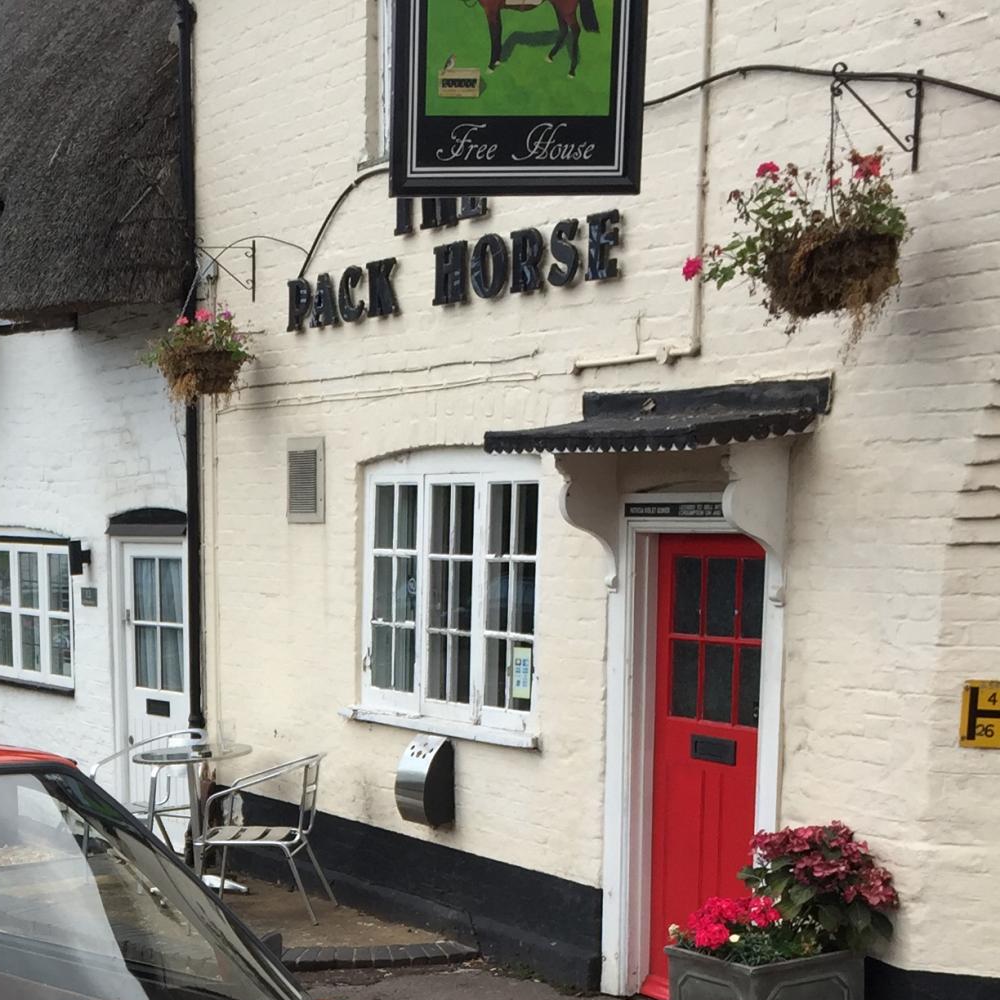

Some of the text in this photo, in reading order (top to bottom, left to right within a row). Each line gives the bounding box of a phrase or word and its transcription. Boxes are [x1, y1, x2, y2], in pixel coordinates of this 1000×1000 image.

[436, 122, 596, 162] Free House
[286, 209, 620, 333] PACK HORSE
[976, 723, 995, 738] 26
